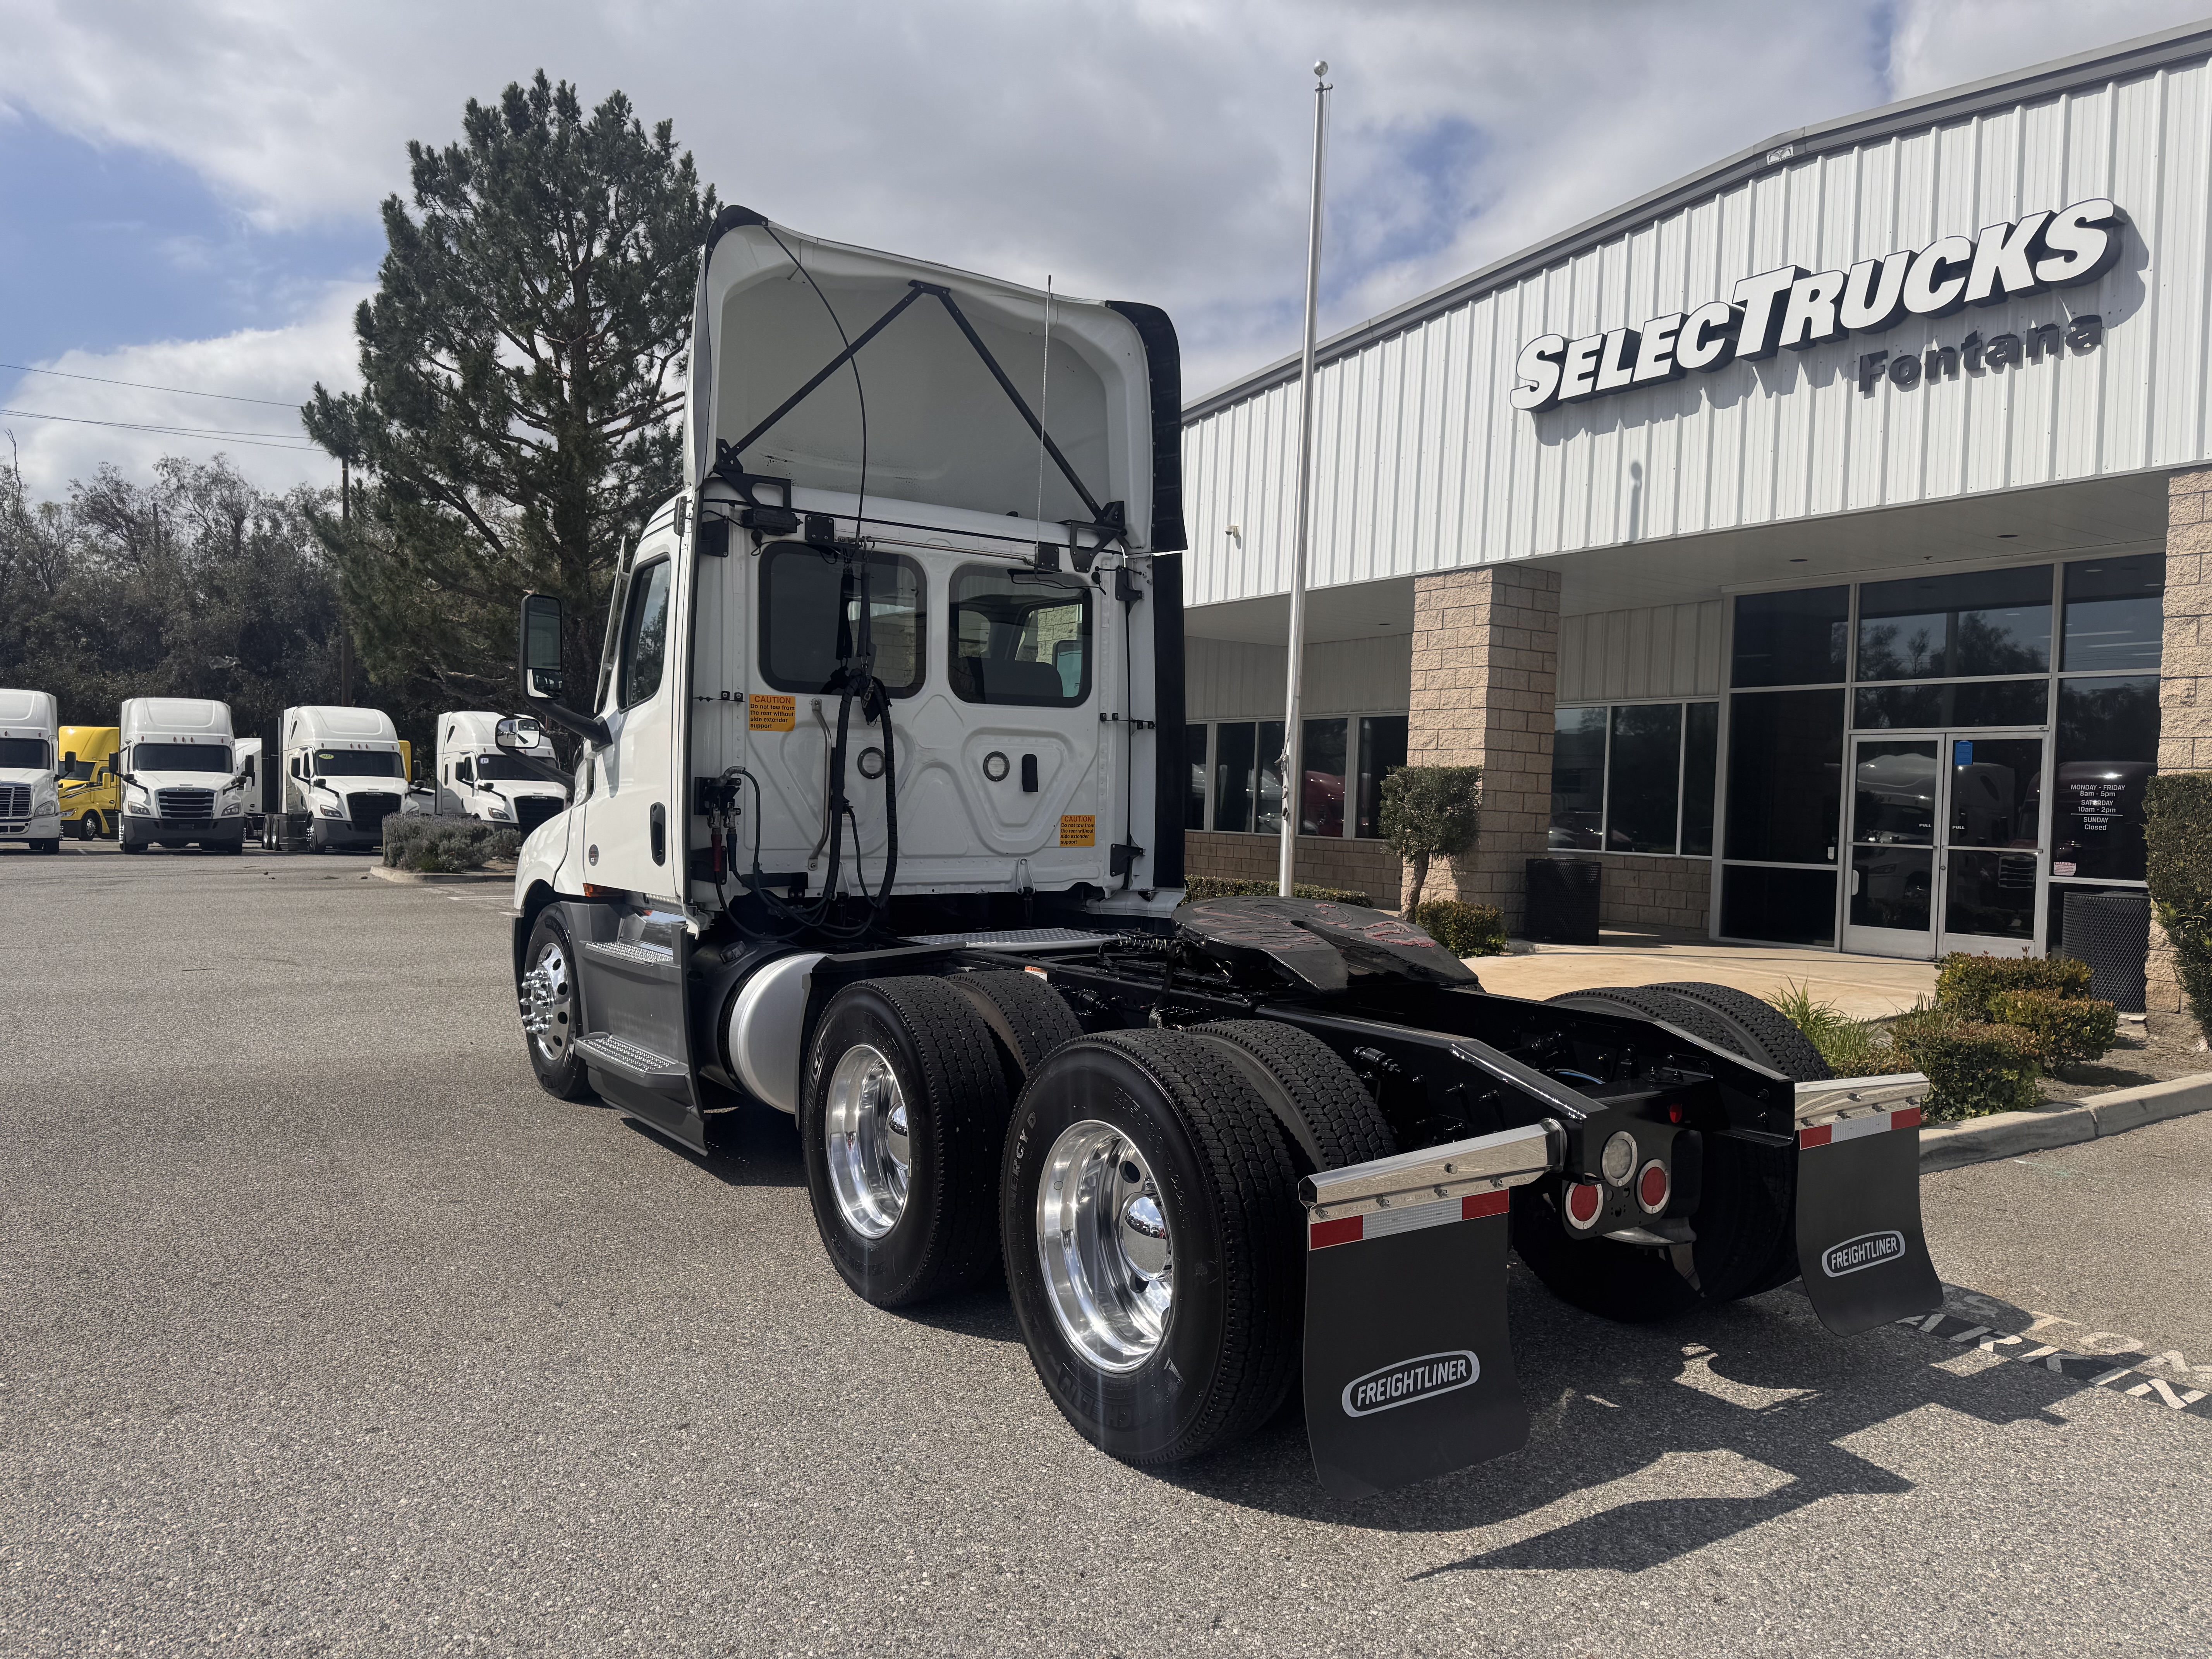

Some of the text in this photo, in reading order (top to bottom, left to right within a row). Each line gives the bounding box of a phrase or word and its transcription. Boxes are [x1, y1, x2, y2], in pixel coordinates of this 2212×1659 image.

[1510, 198, 2127, 413] SELECTRUCKS
[1858, 314, 2104, 393] Fontana
[1008, 1127, 1029, 1224] ENERGY
[1027, 1111, 1036, 1128] D
[1831, 1237, 1898, 1270] FREIGHTLINER
[1357, 1359, 1467, 1407] FREIGHTLINER
[1895, 1314, 2208, 1410] ARKIN
